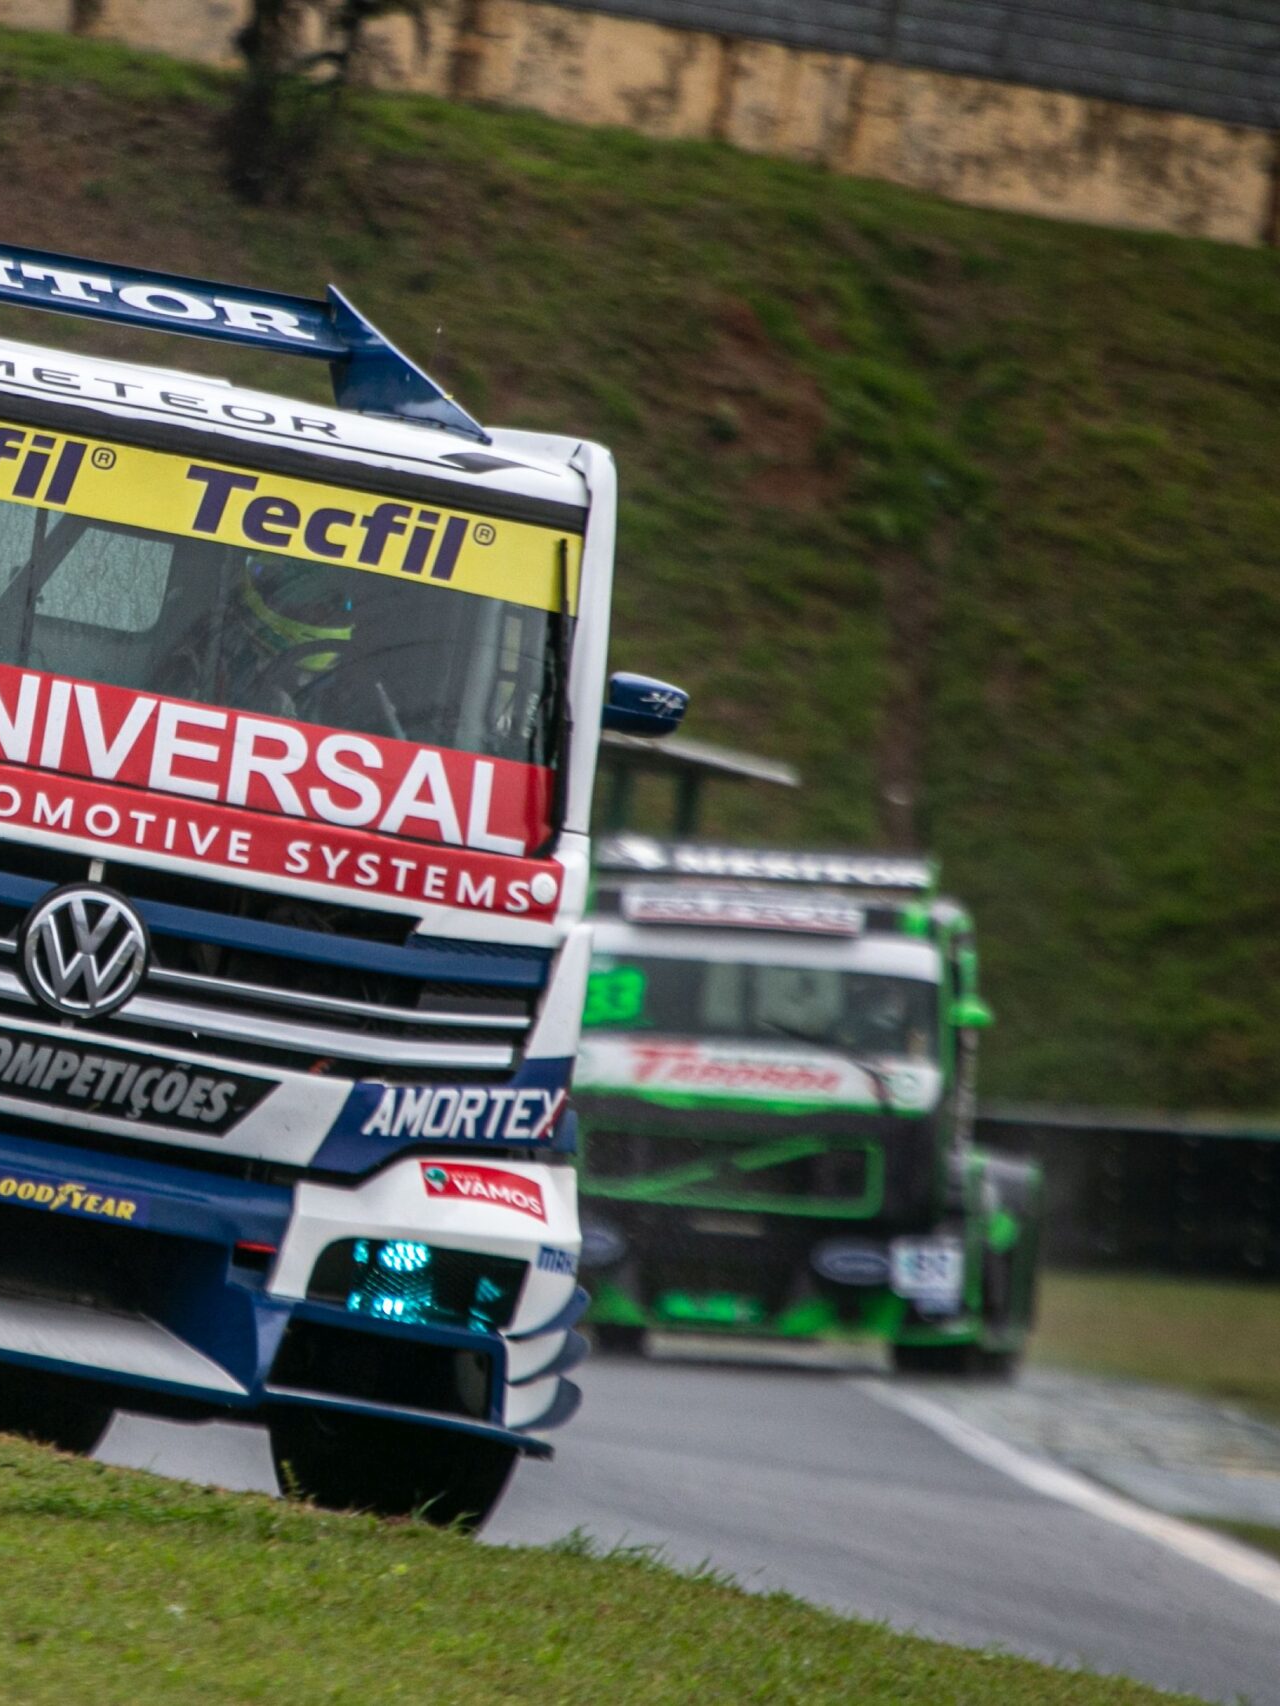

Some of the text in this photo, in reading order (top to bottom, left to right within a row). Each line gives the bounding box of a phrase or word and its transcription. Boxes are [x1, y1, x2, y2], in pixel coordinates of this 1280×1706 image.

[284, 840, 533, 914] SYSTEMS
[361, 1086, 569, 1140] AMORTEX
[451, 1177, 543, 1216] VAMOS
